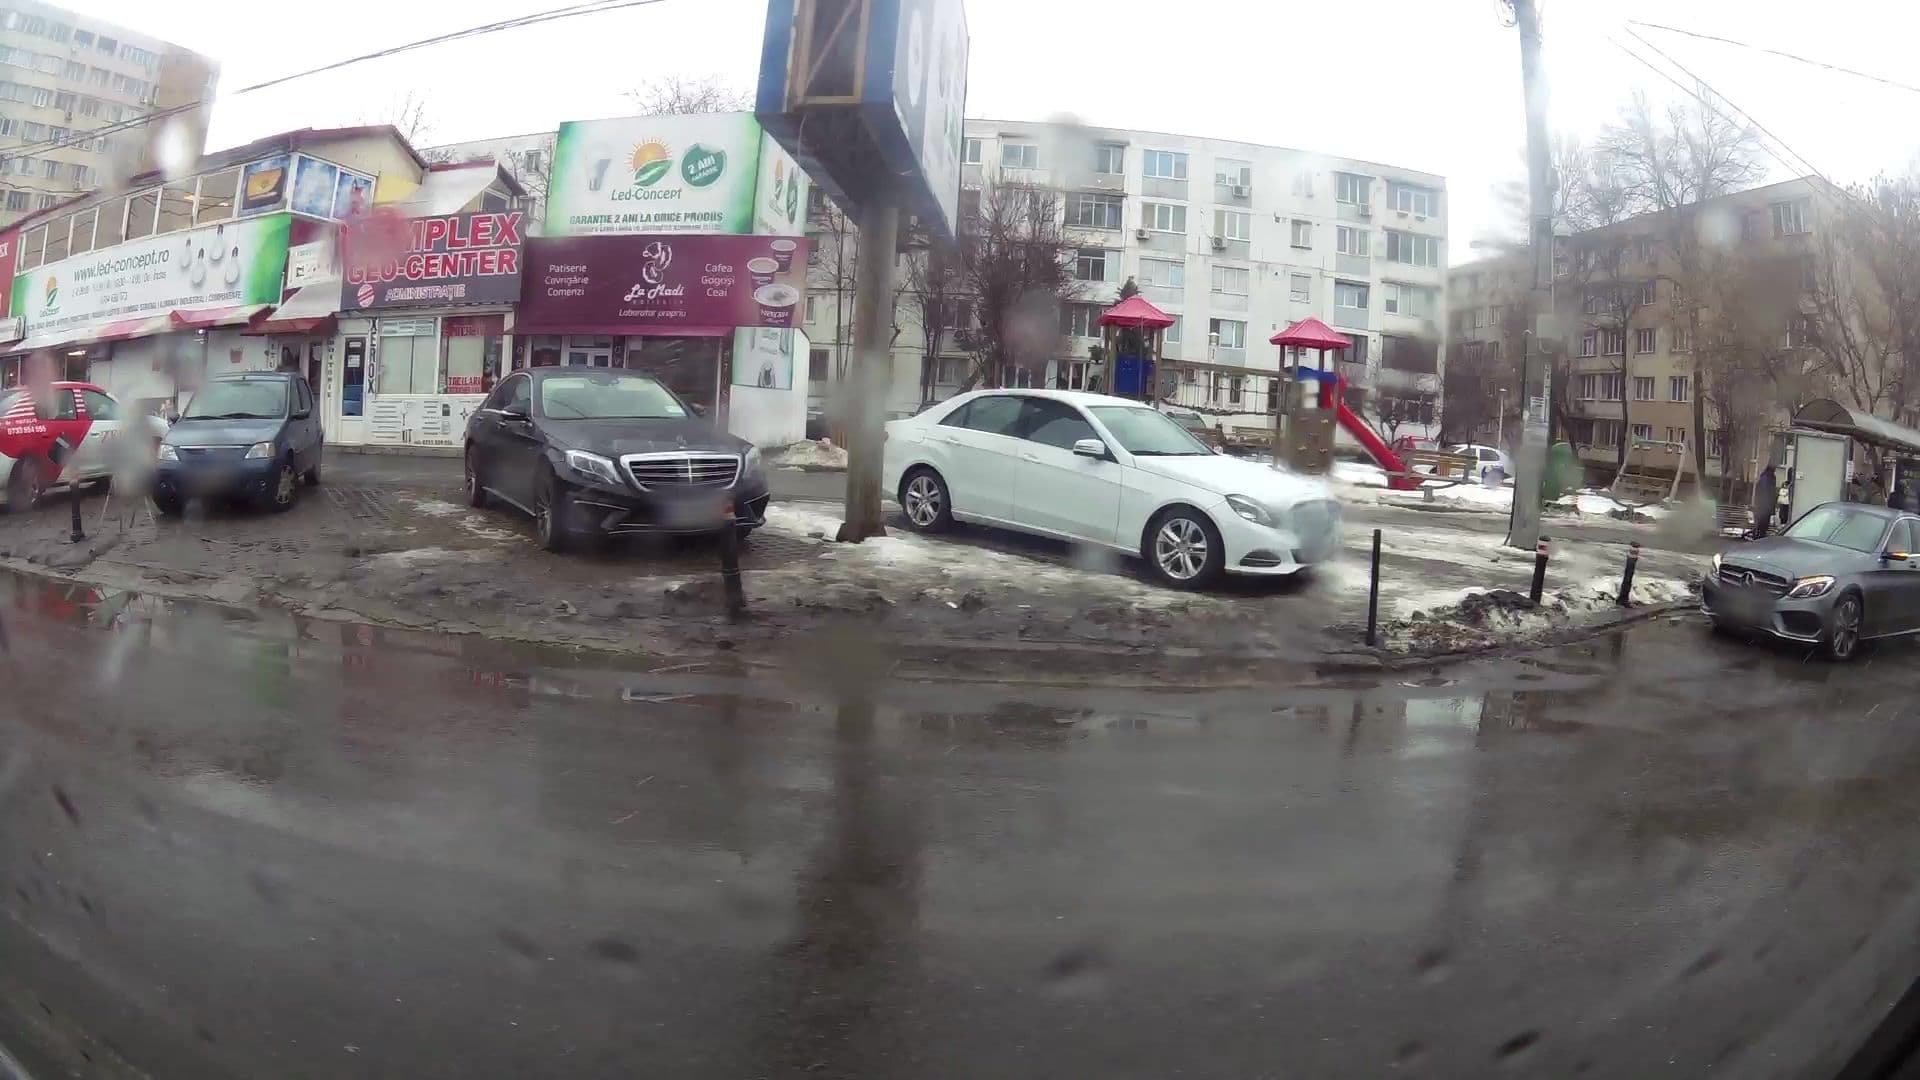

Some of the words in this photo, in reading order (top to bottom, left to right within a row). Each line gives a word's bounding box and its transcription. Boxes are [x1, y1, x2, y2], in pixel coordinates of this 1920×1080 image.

[611, 187, 682, 201] Led-Concept
[614, 213, 621, 223] 2
[622, 213, 638, 223] ANI
[640, 212, 652, 222] LA
[74, 249, 170, 282] www.led-concept.ro
[549, 264, 588, 273] Patiserie
[705, 263, 733, 273] Cafea
[547, 287, 585, 297] Comenzi
[624, 284, 646, 302] La
[706, 287, 728, 297] Ceai
[367, 316, 378, 394] XEROX
